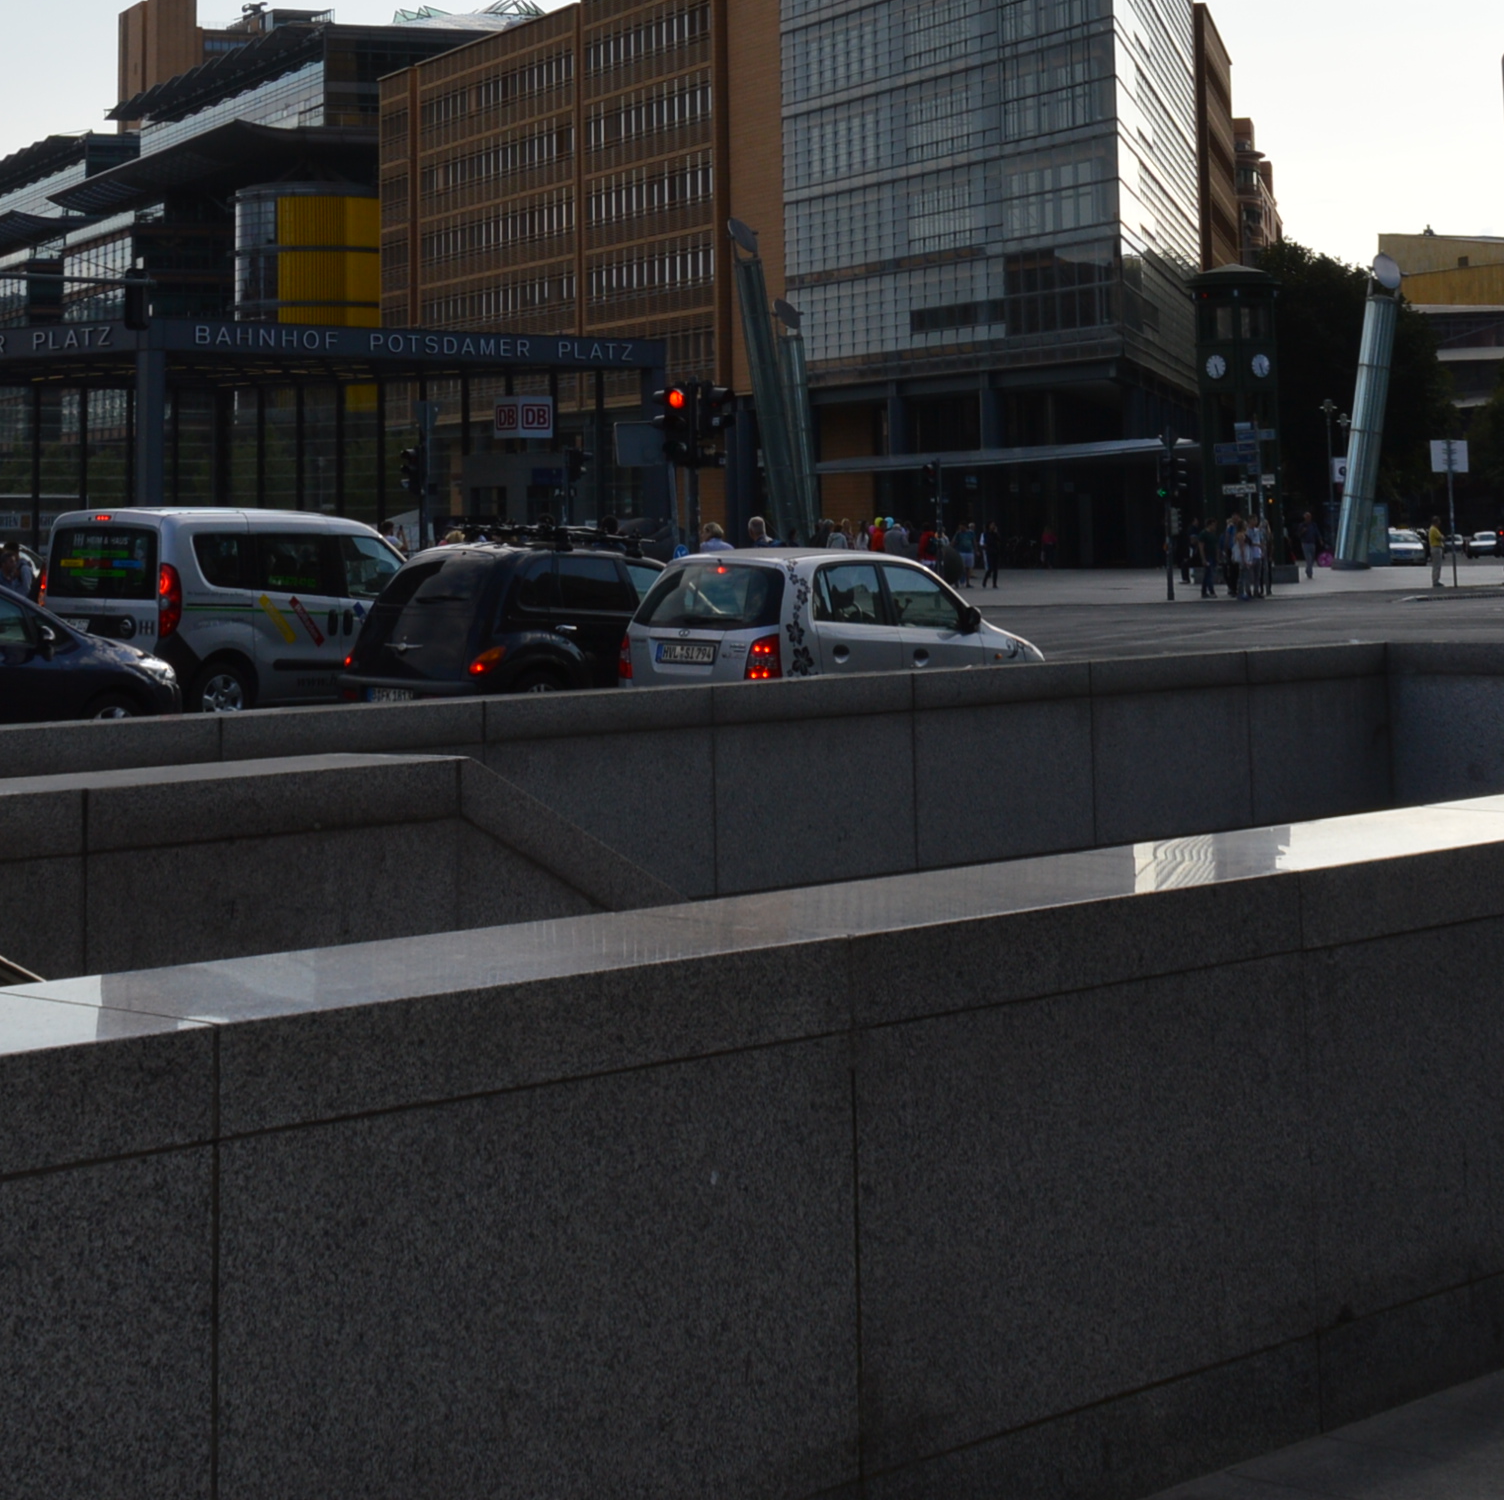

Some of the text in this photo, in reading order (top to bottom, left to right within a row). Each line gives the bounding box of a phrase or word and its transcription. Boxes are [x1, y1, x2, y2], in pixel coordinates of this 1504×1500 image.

[33, 326, 112, 350] PLATZ
[195, 325, 634, 362] BAHNHOF POTSDAMER PLATZ
[498, 408, 515, 426] DB
[525, 408, 547, 425] DB
[663, 645, 678, 659] HVL
